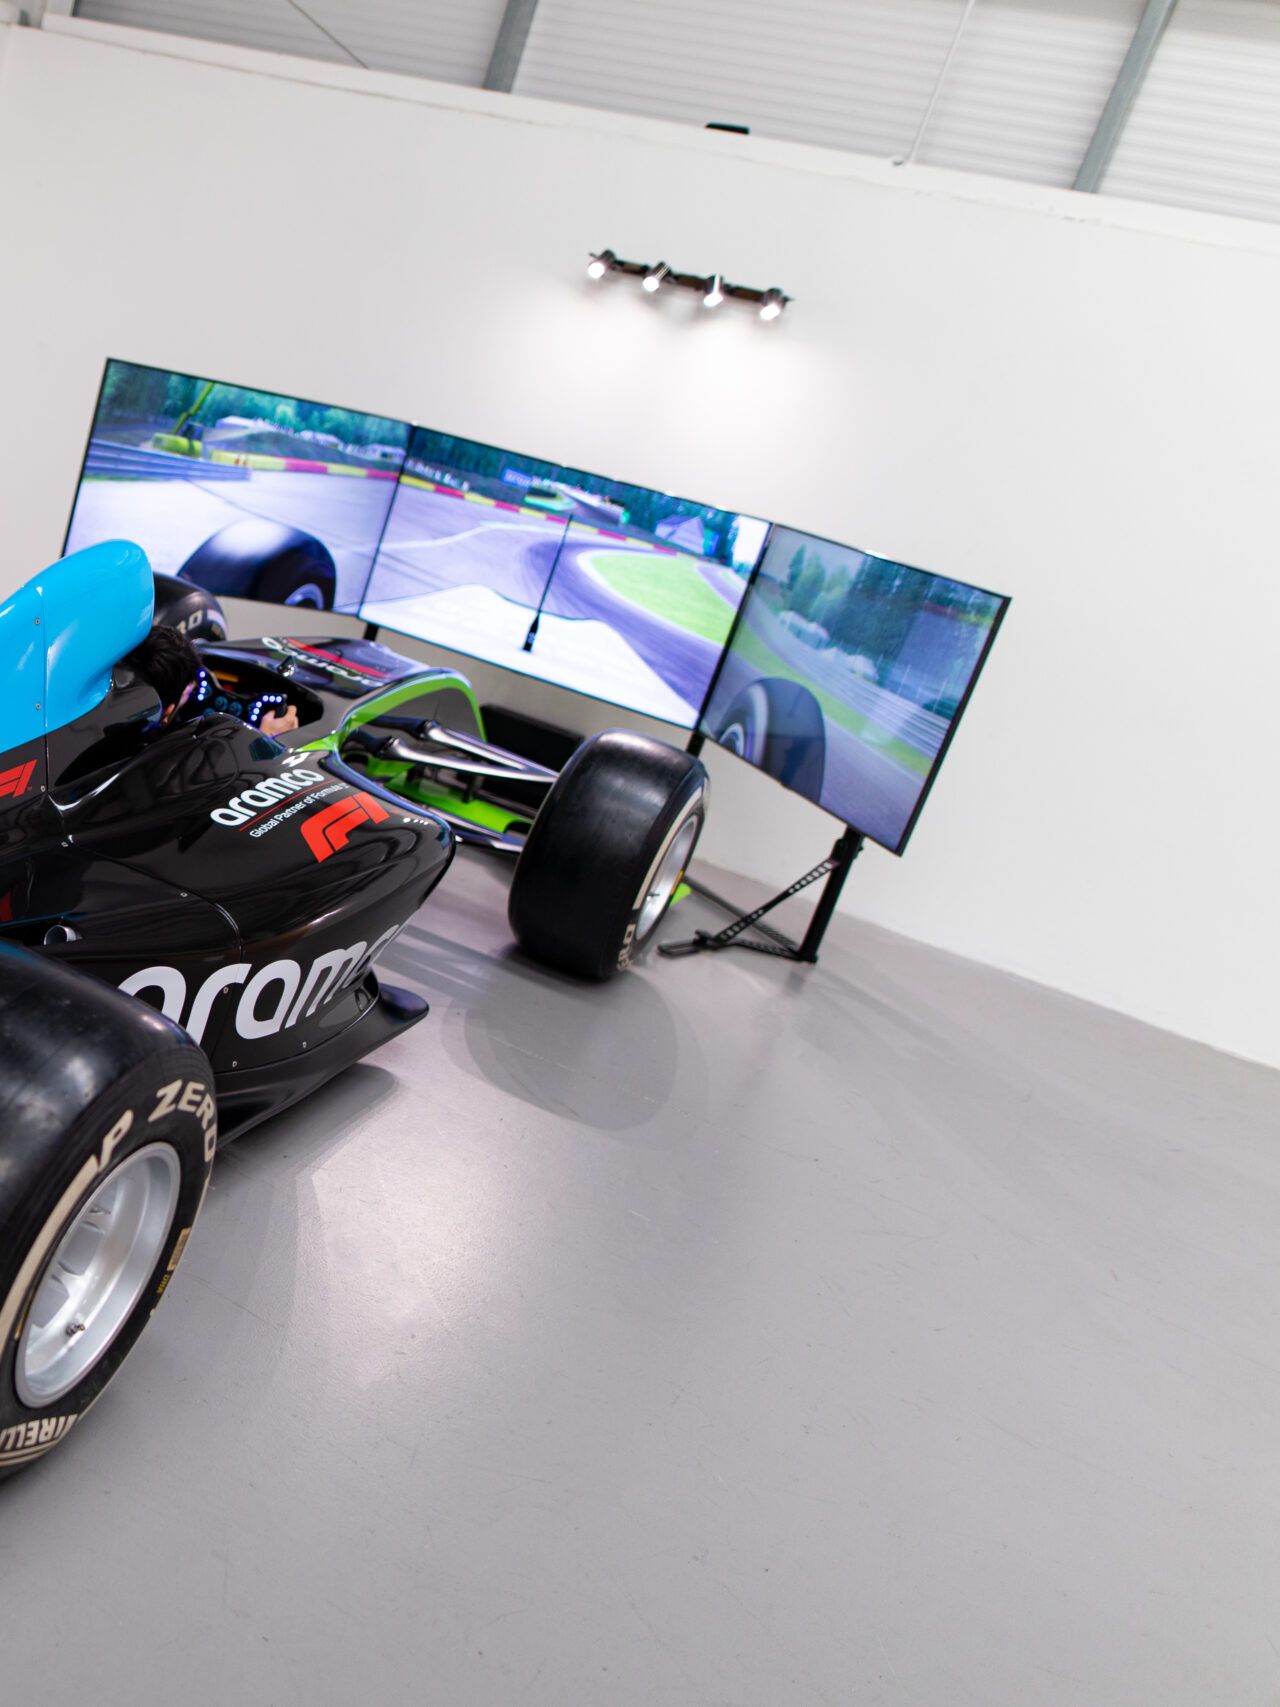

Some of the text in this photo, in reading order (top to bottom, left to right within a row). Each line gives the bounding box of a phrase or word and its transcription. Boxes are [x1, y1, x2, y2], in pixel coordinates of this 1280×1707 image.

[210, 768, 325, 827] aramco
[249, 818, 277, 838] Global
[277, 801, 306, 822] Partner
[305, 793, 314, 804] of
[313, 784, 342, 799] Formula
[300, 791, 391, 863] F1
[147, 1079, 218, 1163] ZERO
